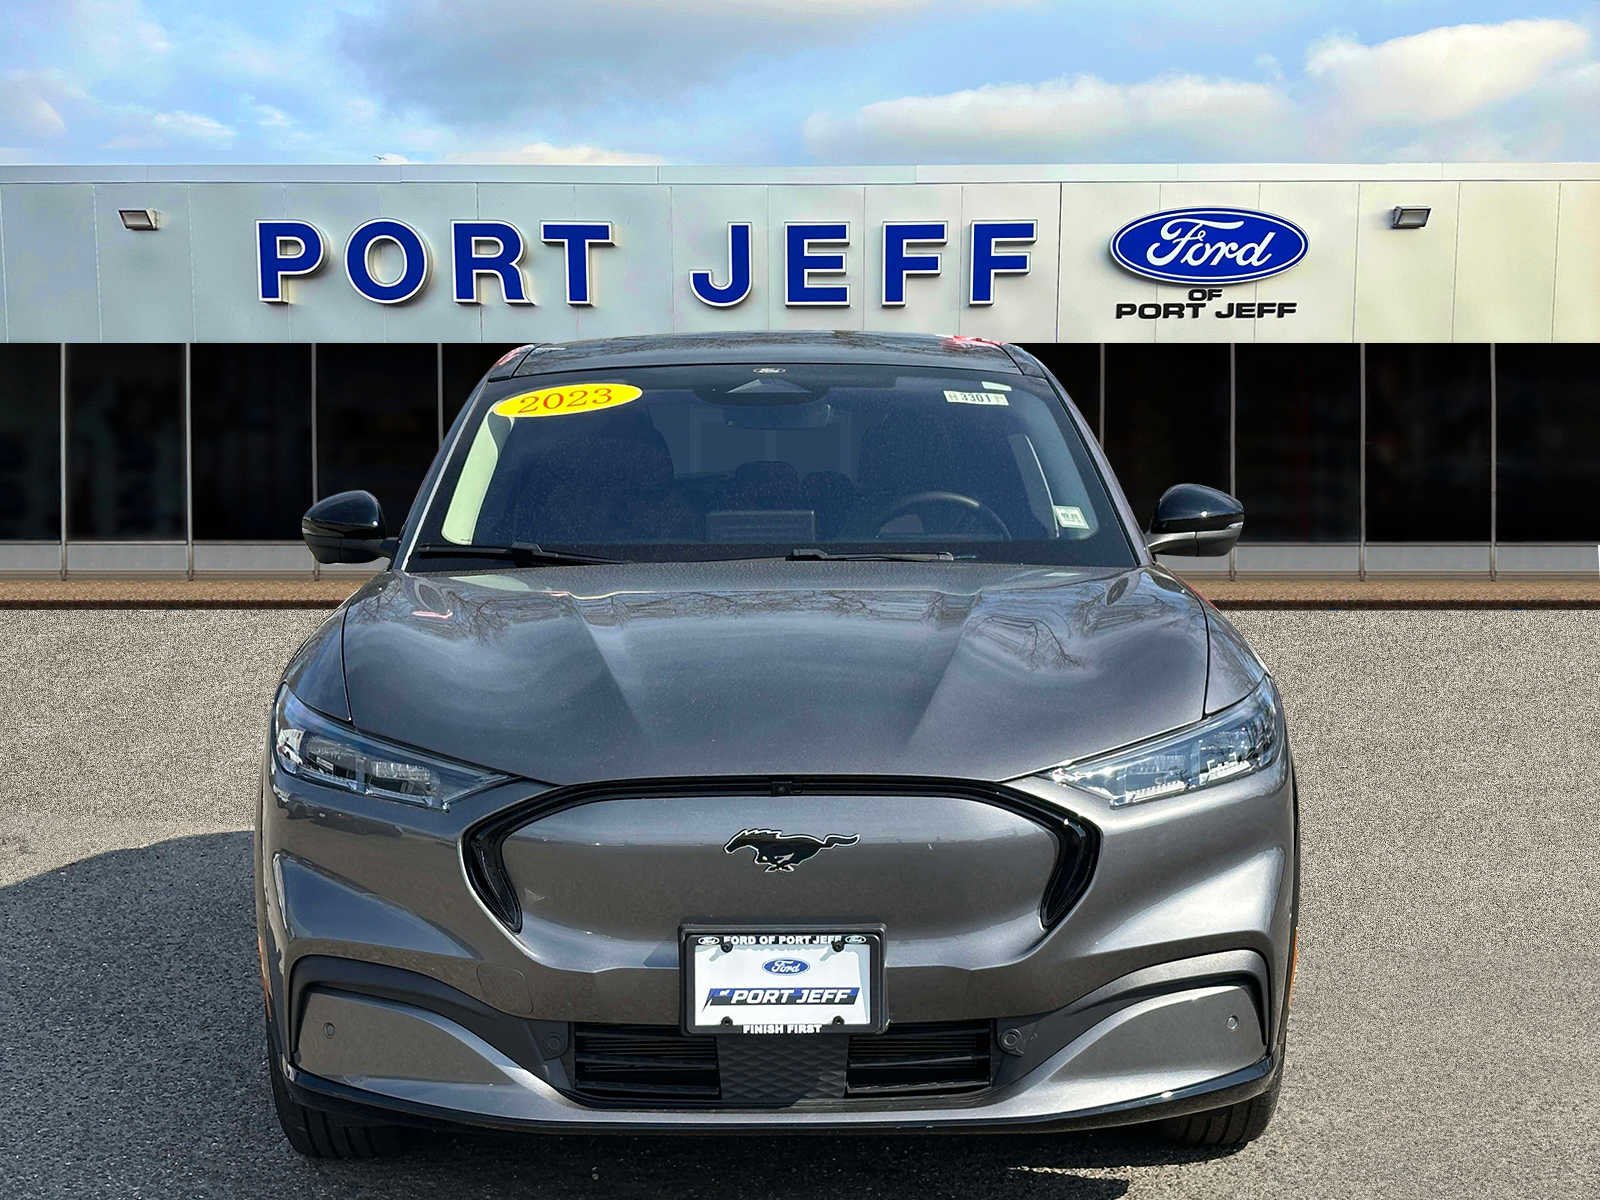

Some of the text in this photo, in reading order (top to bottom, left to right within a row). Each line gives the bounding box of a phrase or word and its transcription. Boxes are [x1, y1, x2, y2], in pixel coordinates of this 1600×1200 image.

[1146, 217, 1277, 267] Ford
[255, 217, 1039, 307] PORT JEFF
[1187, 288, 1223, 301] OF
[1115, 302, 1298, 319] PORT JEFF
[517, 387, 613, 414] 2023
[723, 935, 842, 945] FORD OF PORT JEFF
[770, 960, 801, 974] Ford
[730, 988, 851, 1004] PORT JEFF
[743, 1024, 823, 1034] FINISH FIRST
